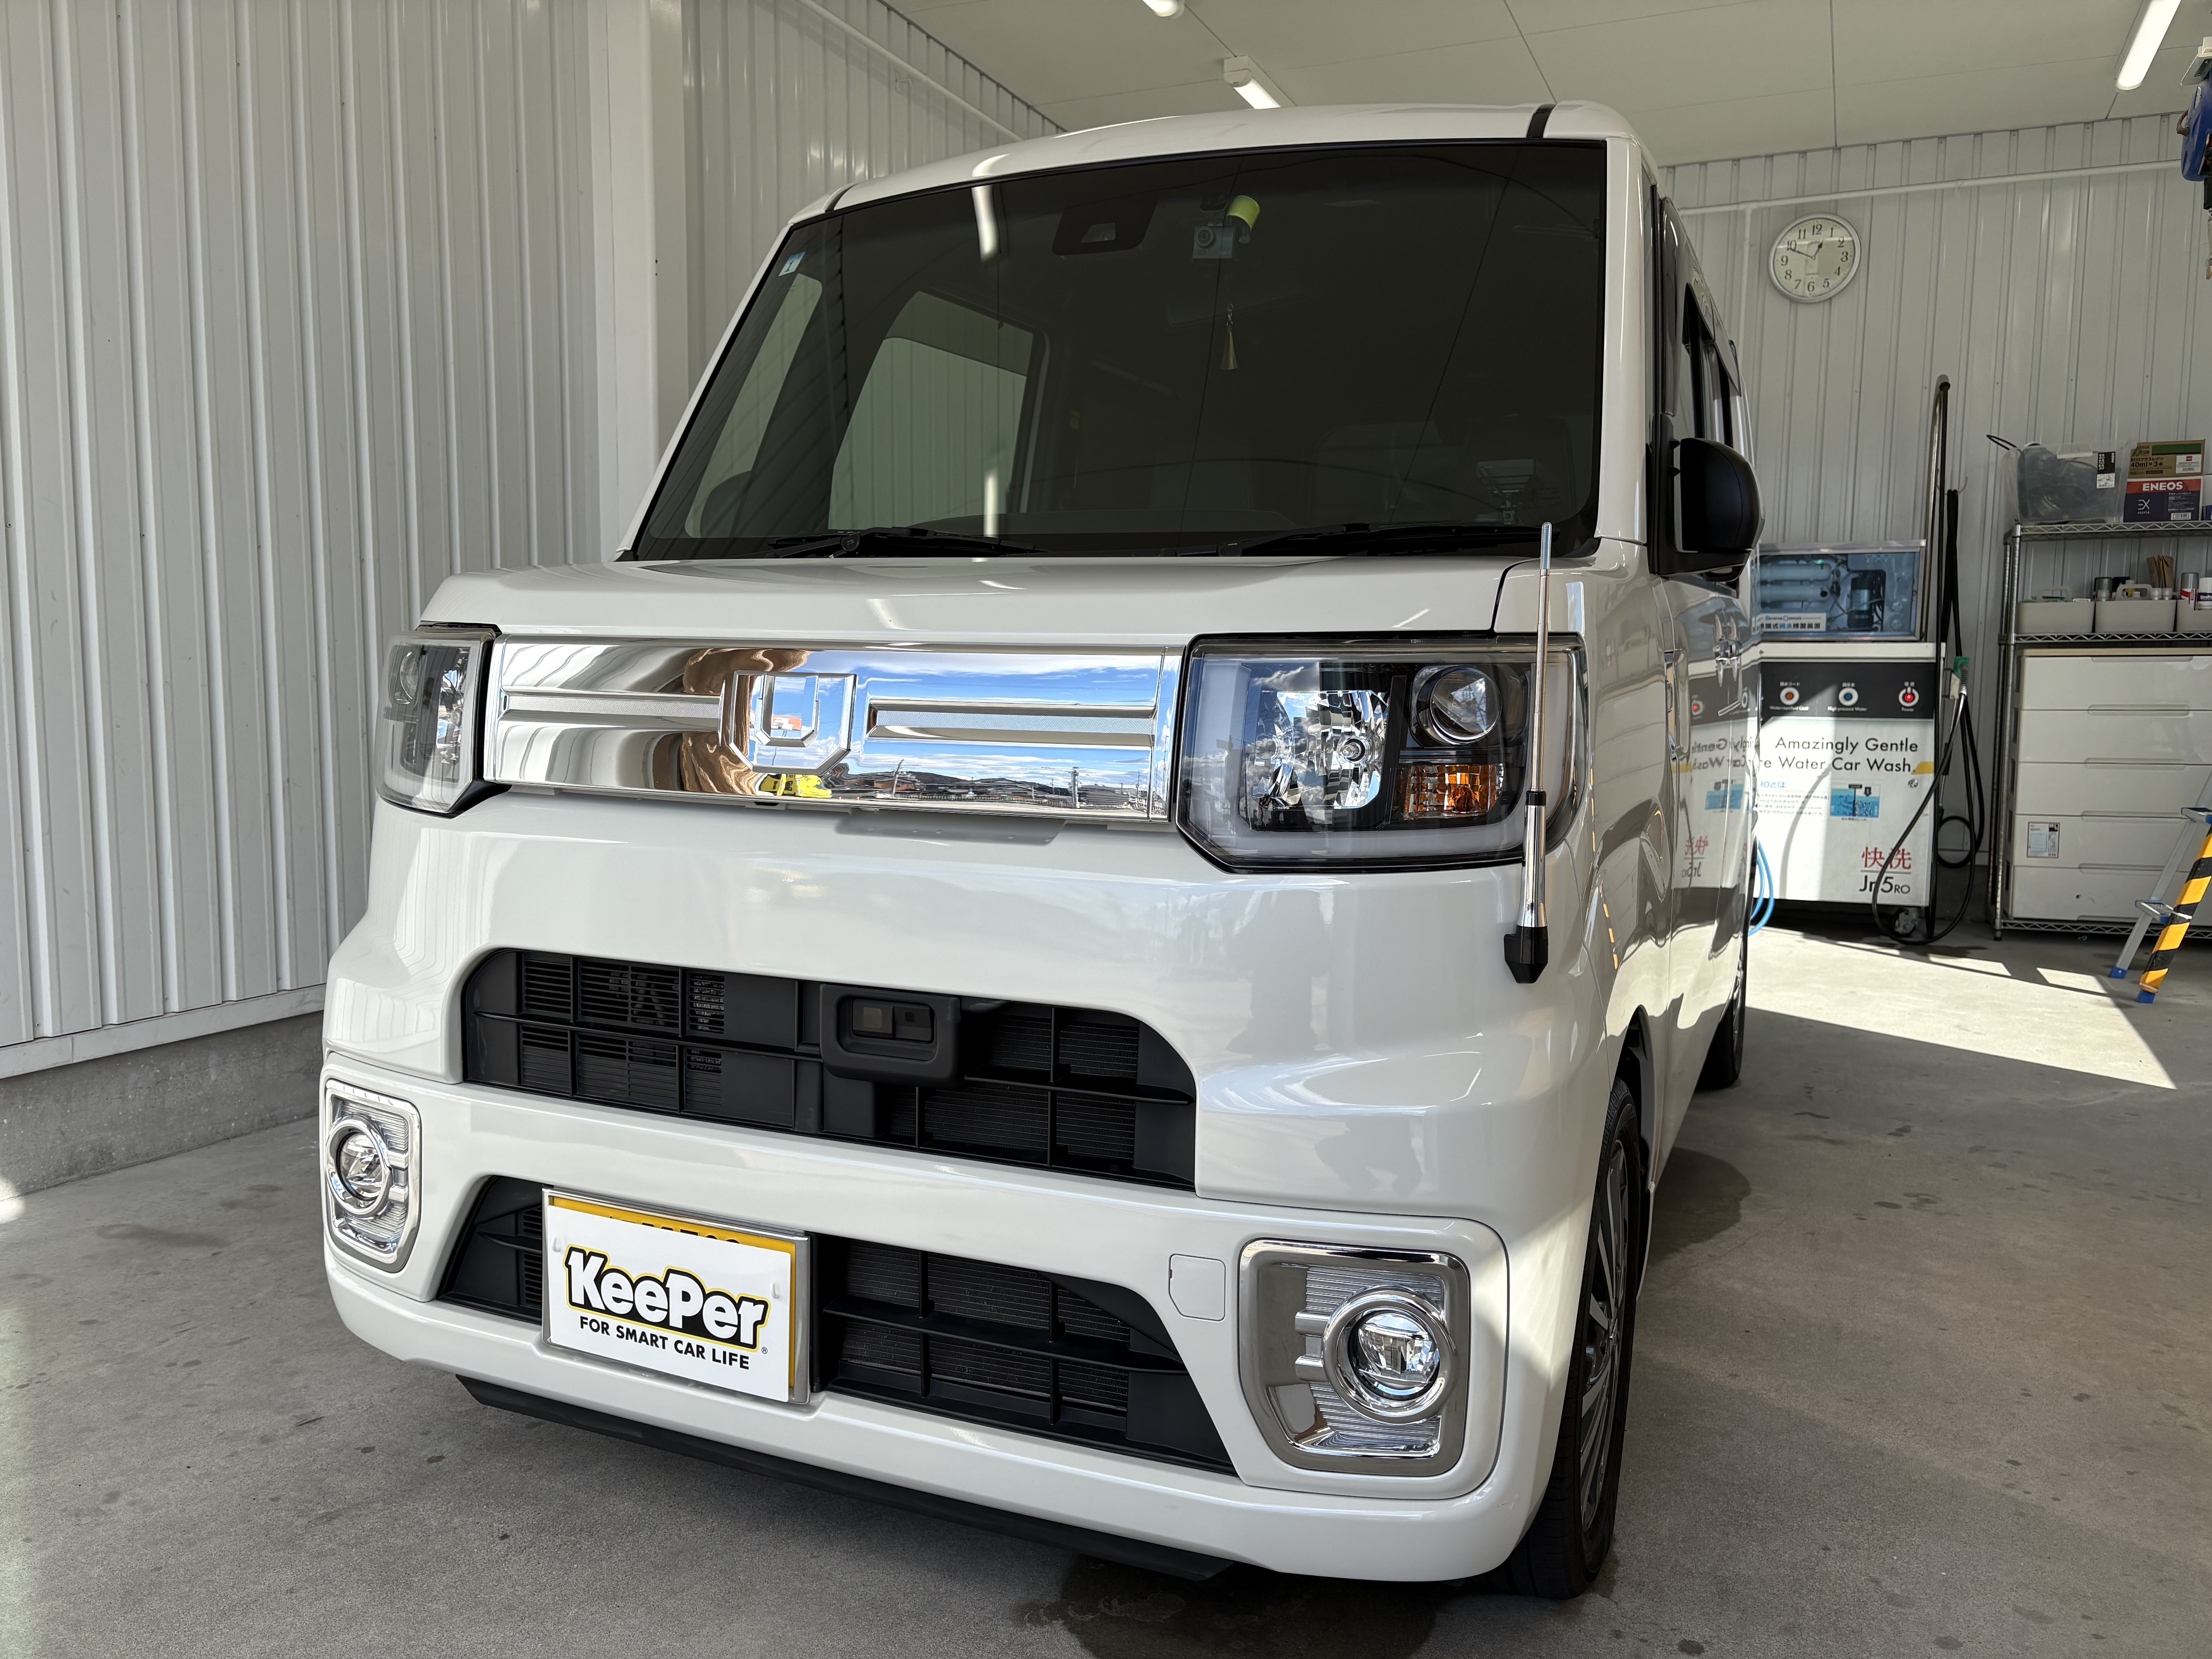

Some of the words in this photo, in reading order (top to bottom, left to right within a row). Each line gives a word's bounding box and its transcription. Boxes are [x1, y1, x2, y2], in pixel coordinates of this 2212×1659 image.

[1798, 229, 1806, 240] 11
[1812, 224, 1822, 236] 12
[1830, 227, 1834, 237] 1
[1787, 240, 1797, 251] 10
[1838, 237, 1845, 248] 2
[1781, 255, 1788, 266] 9
[1841, 251, 1849, 263] 3
[1784, 270, 1792, 280] 8
[1834, 266, 1841, 276] 4
[1795, 279, 1802, 290] 7
[1807, 281, 1815, 292] 6
[1823, 278, 1830, 289] 5
[2143, 481, 2183, 491] ENEOS
[1775, 736, 1859, 754] Amazingly
[1865, 738, 1918, 753] Gentle
[1778, 756, 1825, 769] Water
[1832, 757, 1860, 771] Car
[563, 1245, 770, 1352] KeePer
[580, 1316, 610, 1336] FOR
[616, 1325, 668, 1350] SMART
[674, 1340, 706, 1360] CAR
[712, 1348, 749, 1370] LIFE
